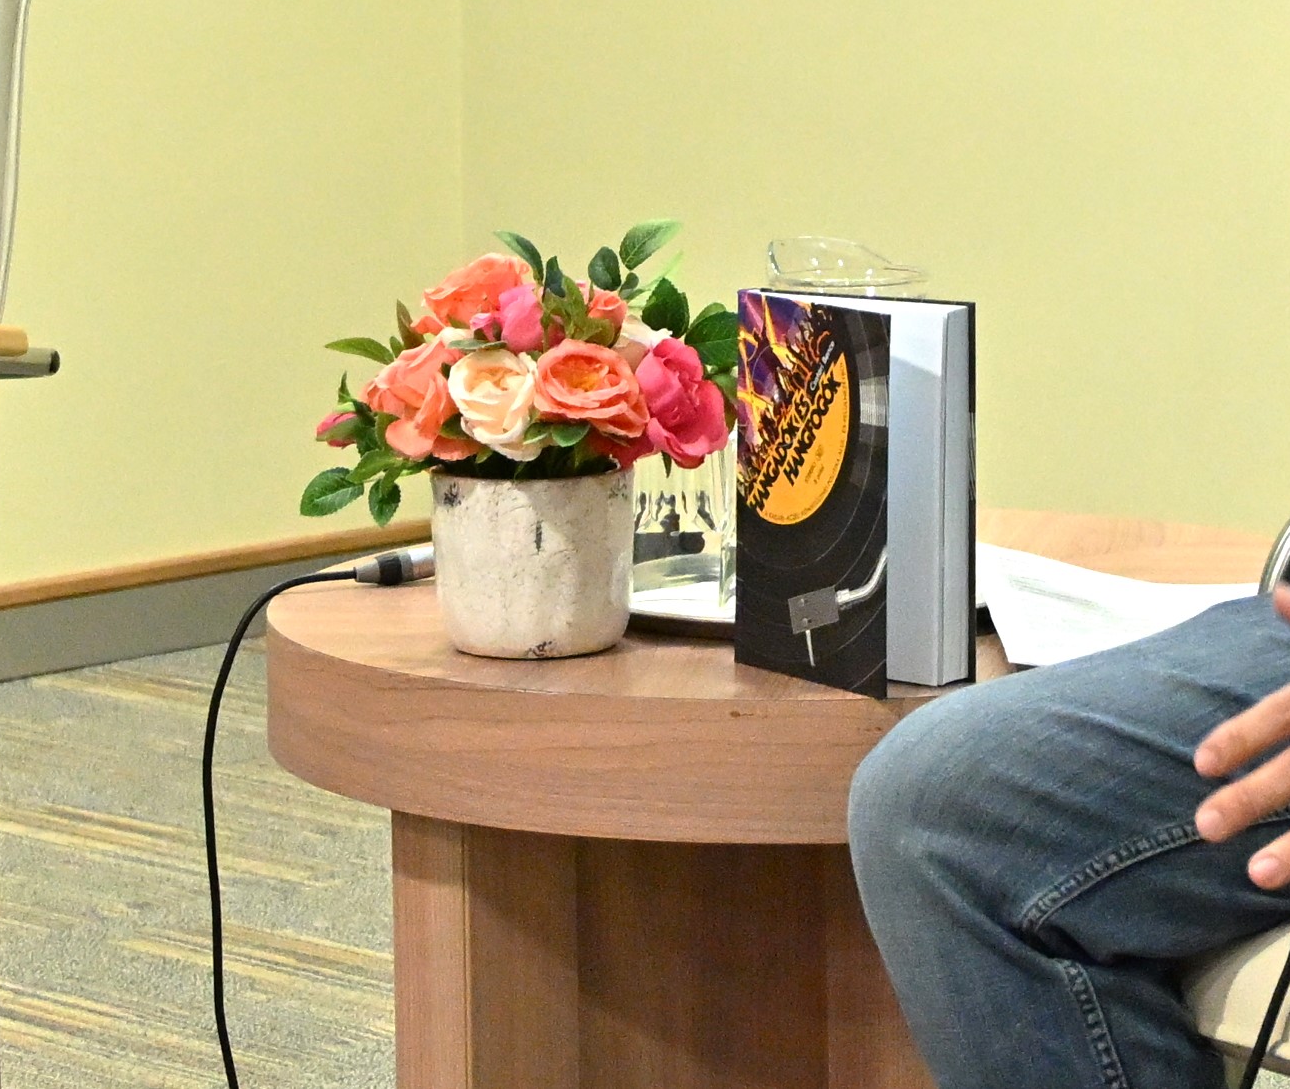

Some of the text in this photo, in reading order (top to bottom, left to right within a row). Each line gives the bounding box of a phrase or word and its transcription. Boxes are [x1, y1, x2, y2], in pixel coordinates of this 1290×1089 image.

[822, 340, 836, 365] Bence
[748, 416, 801, 512] HANGADÓK
[782, 370, 841, 487] HANGFOGÓK
